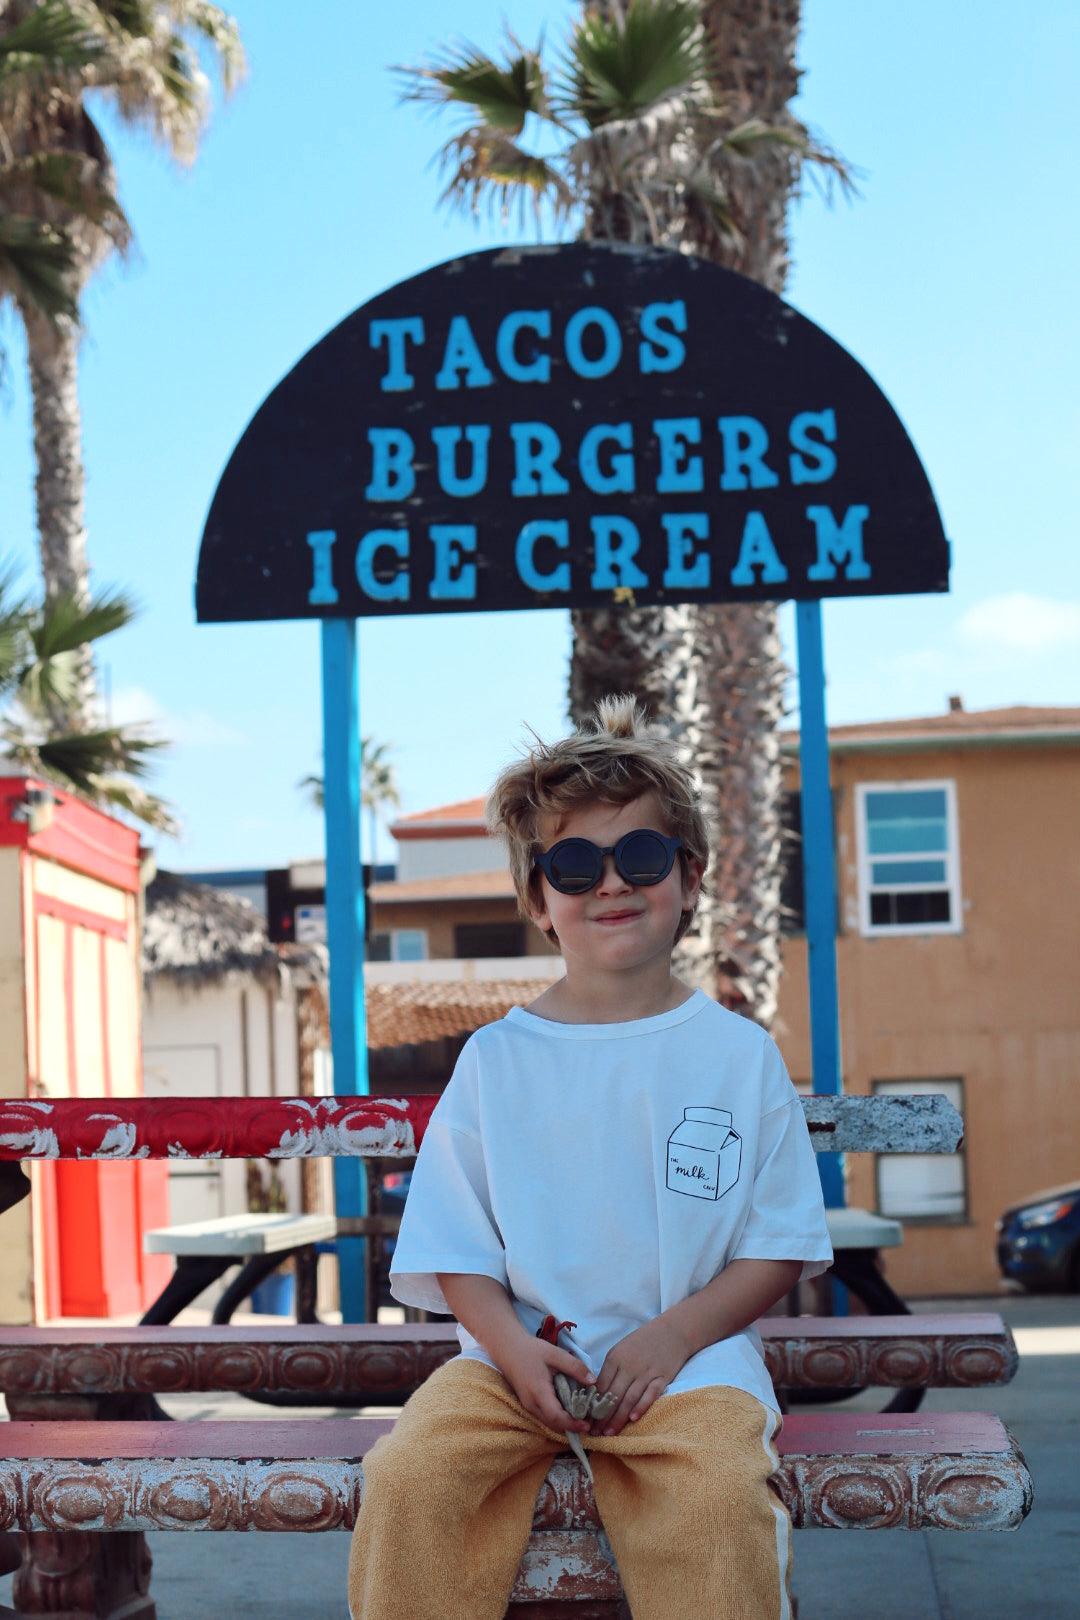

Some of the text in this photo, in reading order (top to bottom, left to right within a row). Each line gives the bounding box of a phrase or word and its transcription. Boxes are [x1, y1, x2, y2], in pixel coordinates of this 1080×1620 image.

[370, 299, 688, 392] TACOS
[365, 408, 837, 502] BURGERS
[306, 504, 872, 605] ICE CREAM
[675, 1165, 710, 1180] milk
